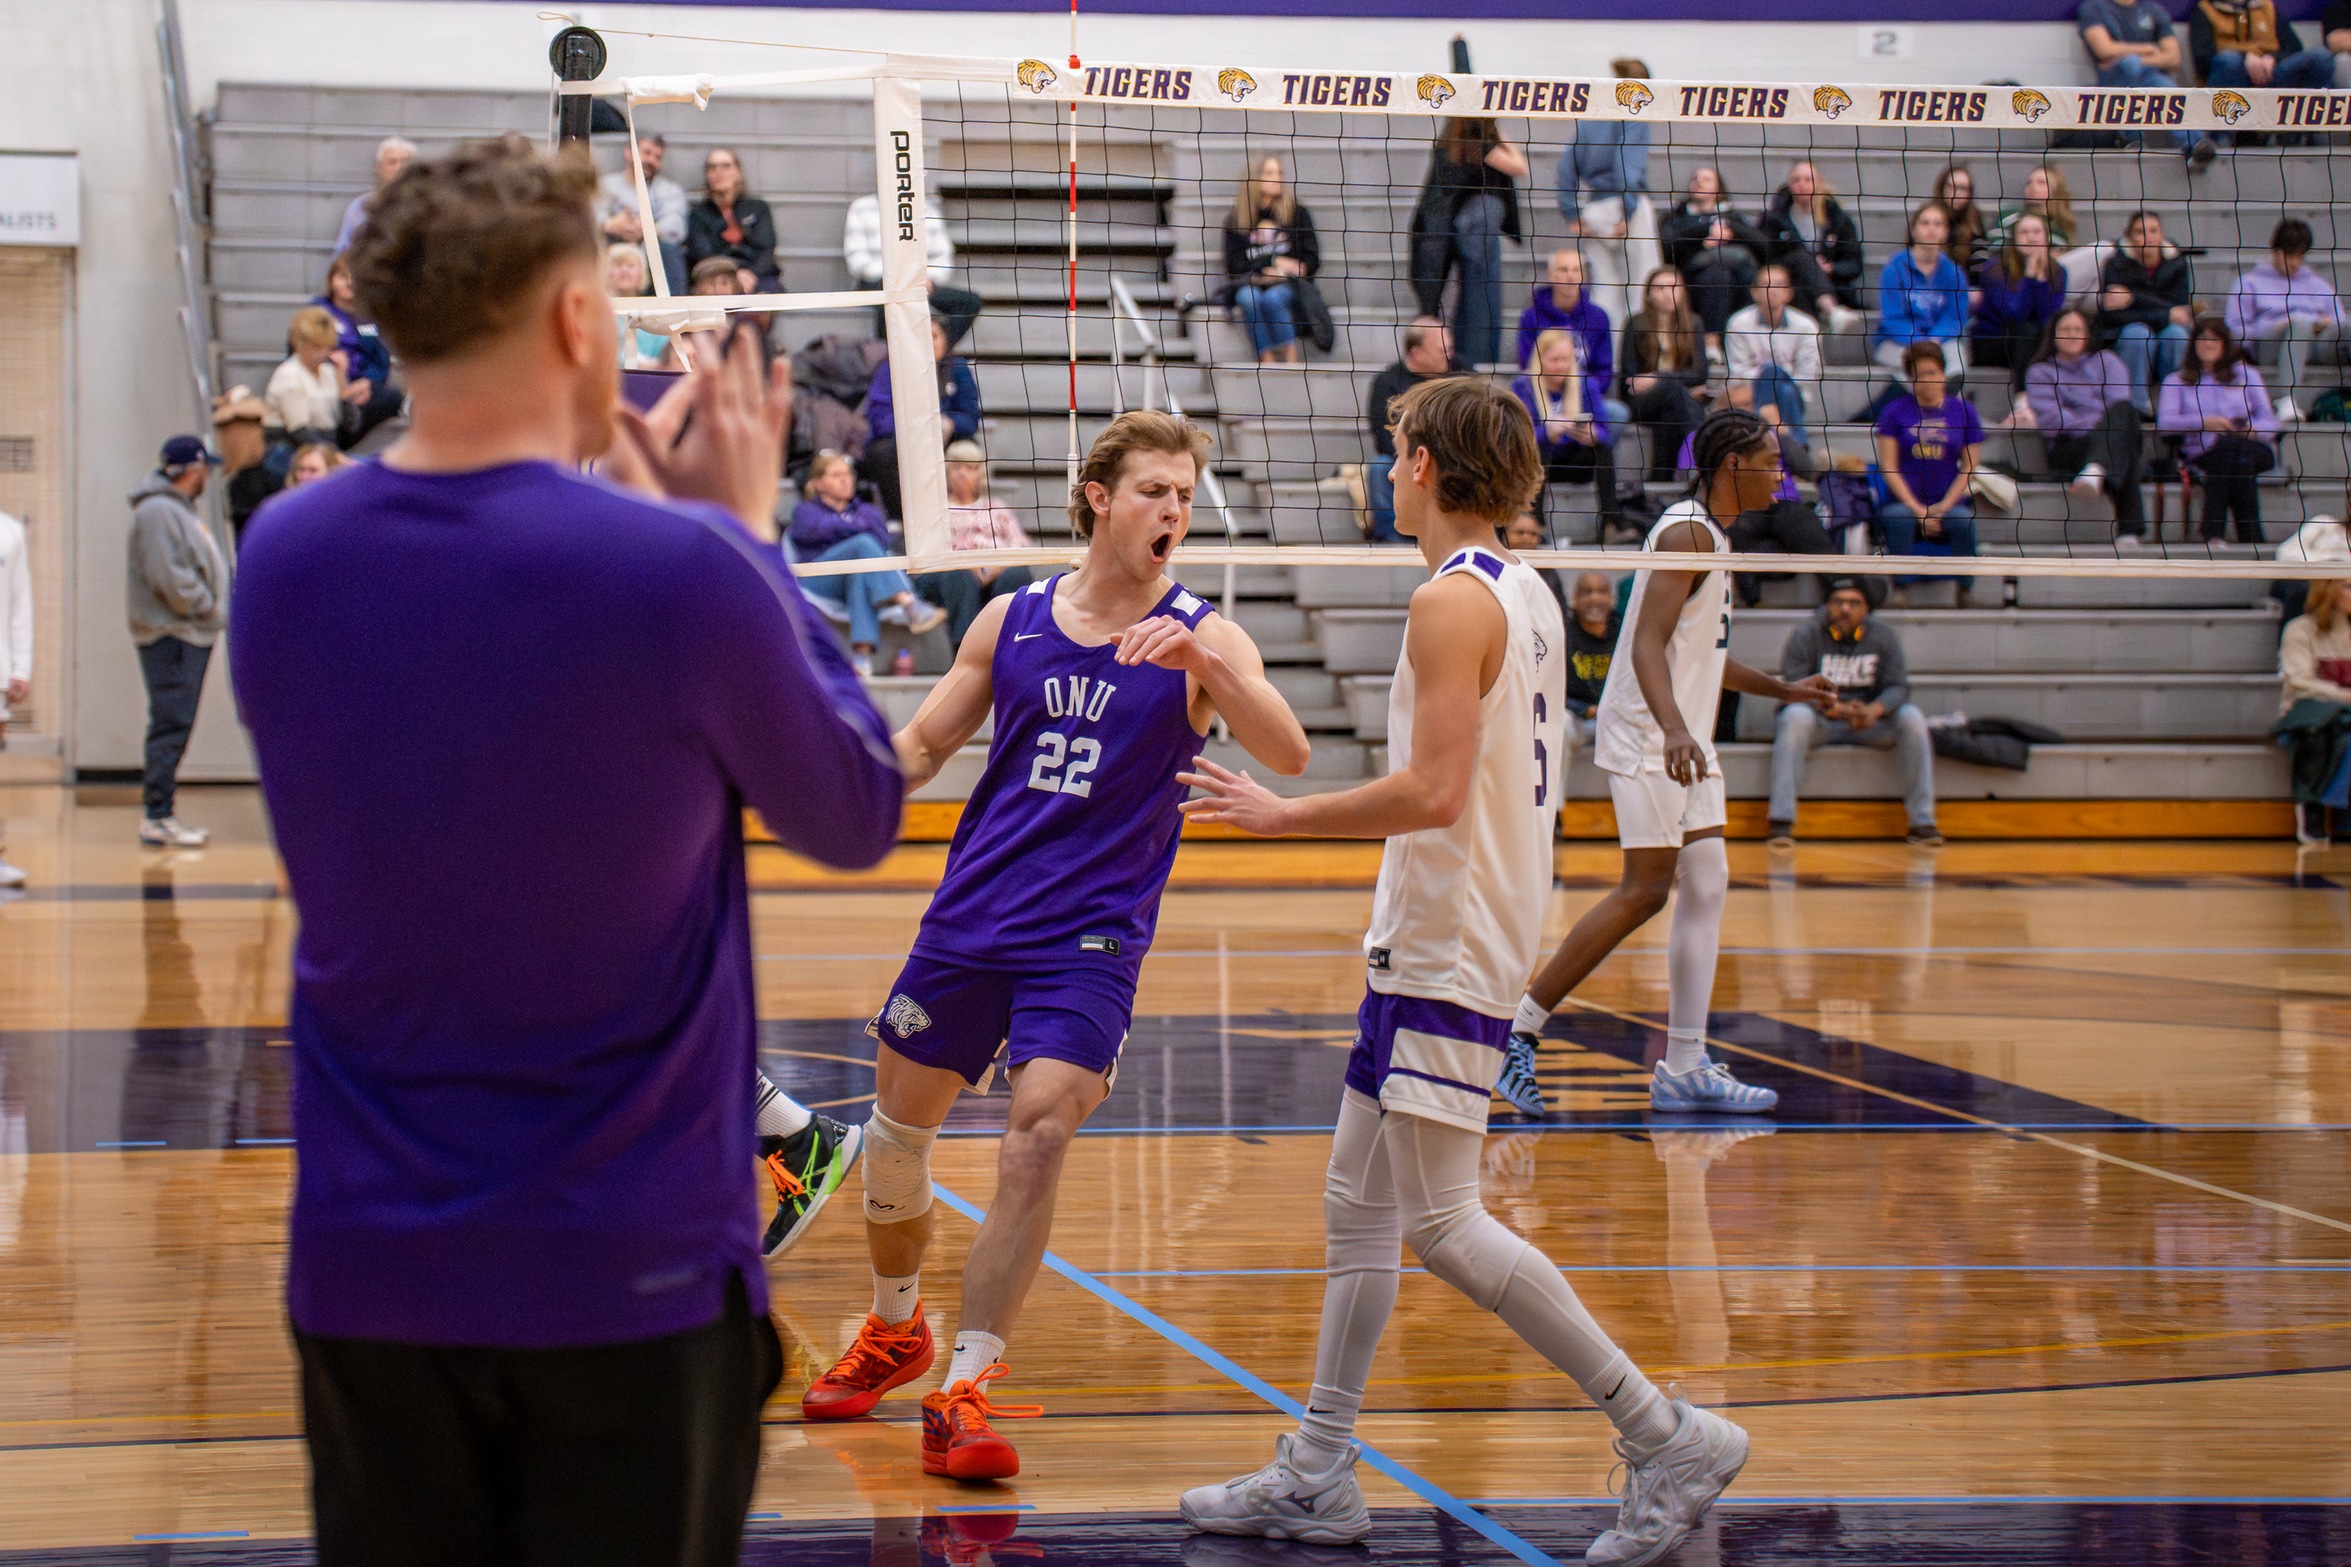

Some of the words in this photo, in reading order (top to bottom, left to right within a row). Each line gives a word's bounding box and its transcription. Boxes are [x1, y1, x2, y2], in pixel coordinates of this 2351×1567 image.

[1872, 31, 1897, 55] 2
[1084, 66, 1192, 100] TIGERS
[1282, 74, 1391, 106] TIGERS
[1482, 80, 1590, 112] TIGERS
[1679, 86, 1788, 118] TIGERS
[1878, 90, 1986, 121] TIGERS
[2077, 93, 2186, 124] TIGERS
[2276, 95, 2351, 126] TIGE
[1044, 675, 1117, 722] ONU
[1027, 731, 1102, 798] 22
